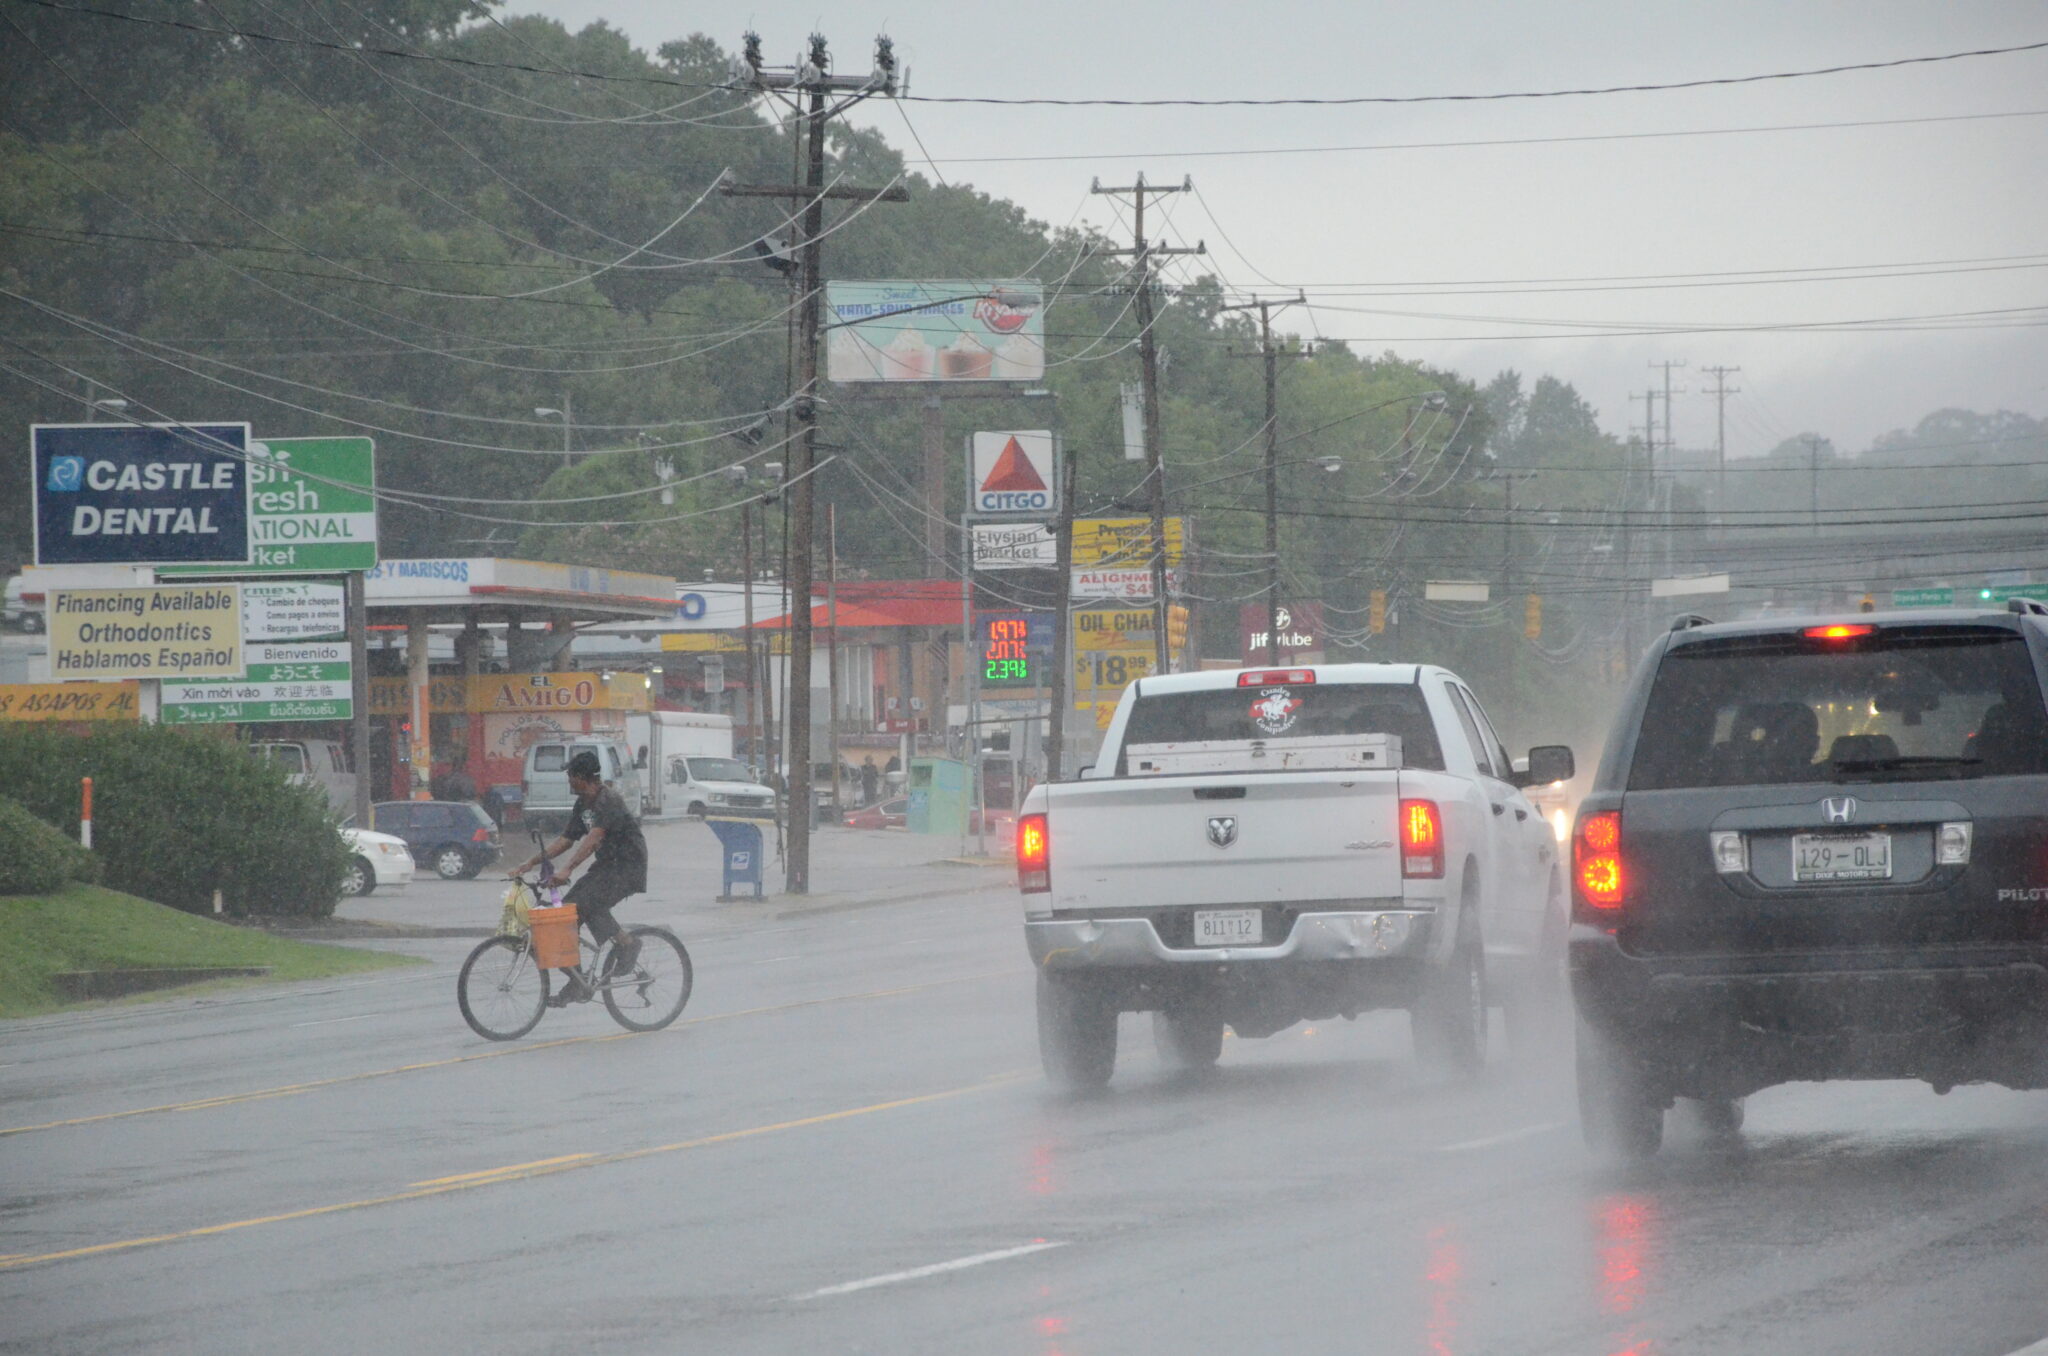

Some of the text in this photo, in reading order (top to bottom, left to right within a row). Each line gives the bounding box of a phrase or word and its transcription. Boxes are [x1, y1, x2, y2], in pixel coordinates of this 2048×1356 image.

[87, 461, 235, 491] CASTLE
[252, 480, 319, 511] resh
[982, 493, 1046, 509] CITGO
[72, 506, 218, 535] DENTAL
[976, 530, 1037, 546] Elysian
[252, 546, 296, 565] rket
[978, 546, 1039, 560] Market
[399, 561, 468, 583] MARISCOS
[56, 591, 231, 616] Financing Available
[266, 598, 294, 607] Cambio
[297, 597, 305, 606] de
[1080, 613, 1154, 632] OIL CHA
[79, 622, 212, 643] Orthodontics
[57, 647, 233, 671] Hablamos Español
[264, 646, 338, 660] Bienvenido
[270, 665, 323, 681] ようこそ
[530, 676, 553, 687] EL
[182, 688, 204, 700] Xin
[274, 685, 334, 698] 欢迎光临
[495, 681, 594, 708] AMIGO
